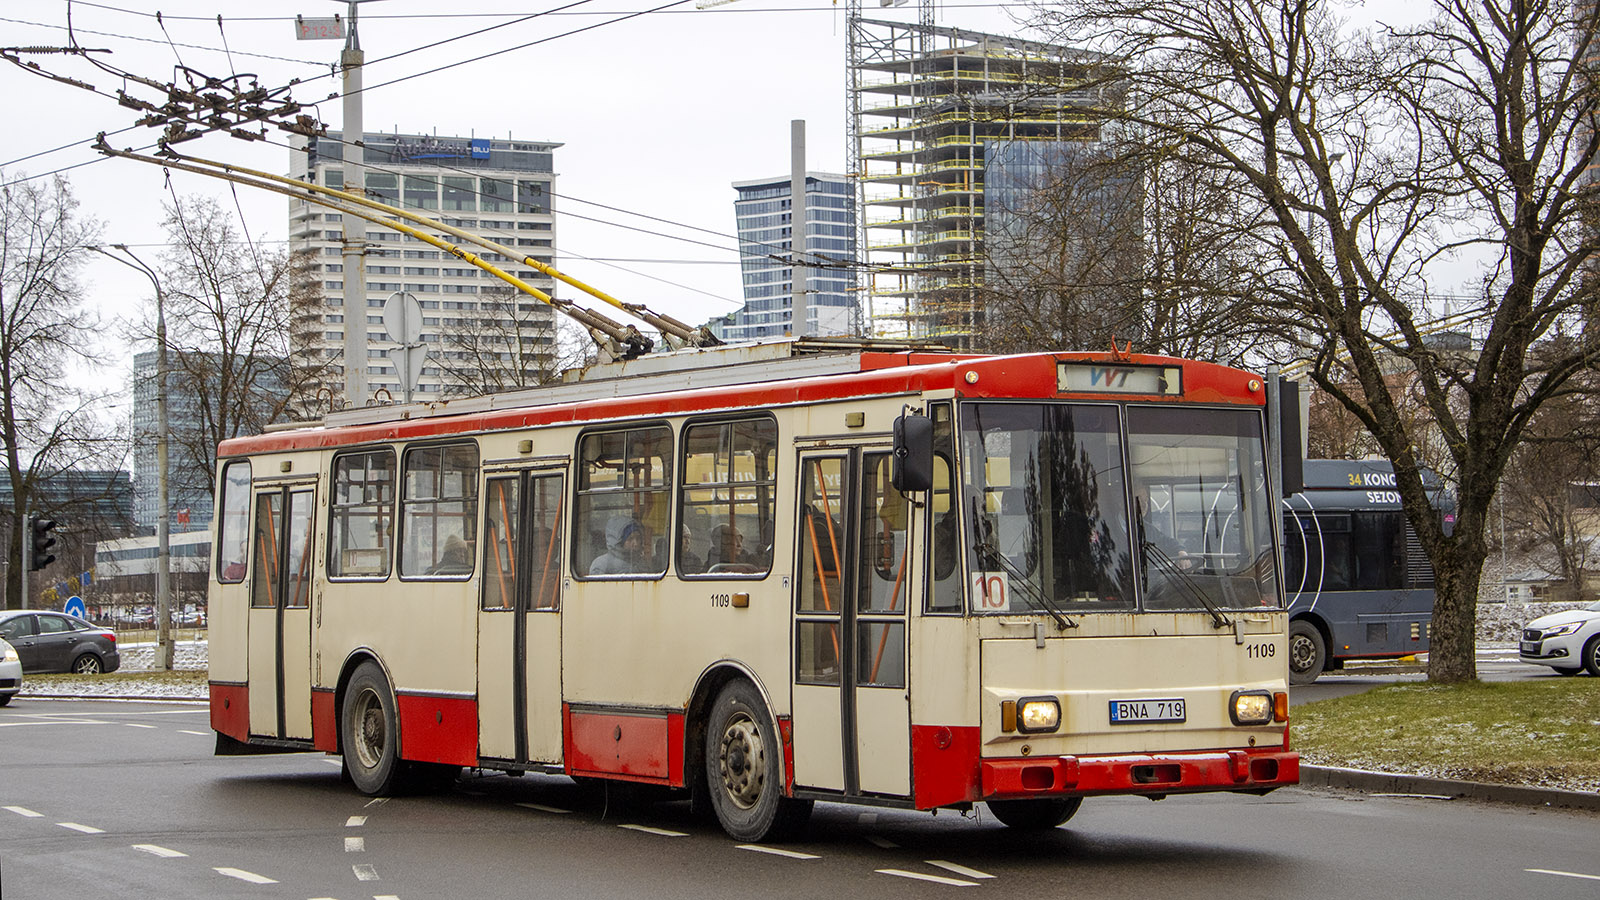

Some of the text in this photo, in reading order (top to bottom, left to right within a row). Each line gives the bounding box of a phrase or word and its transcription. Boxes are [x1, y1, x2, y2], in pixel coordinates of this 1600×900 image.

[1091, 366, 1135, 388] VVT
[1347, 473, 1362, 486] 34
[1366, 491, 1401, 503] SEZON
[975, 575, 1005, 608] 10
[710, 593, 730, 608] 1109
[1246, 643, 1276, 658] 1109
[1119, 703, 1149, 719] BNA
[1157, 702, 1182, 718] 719
